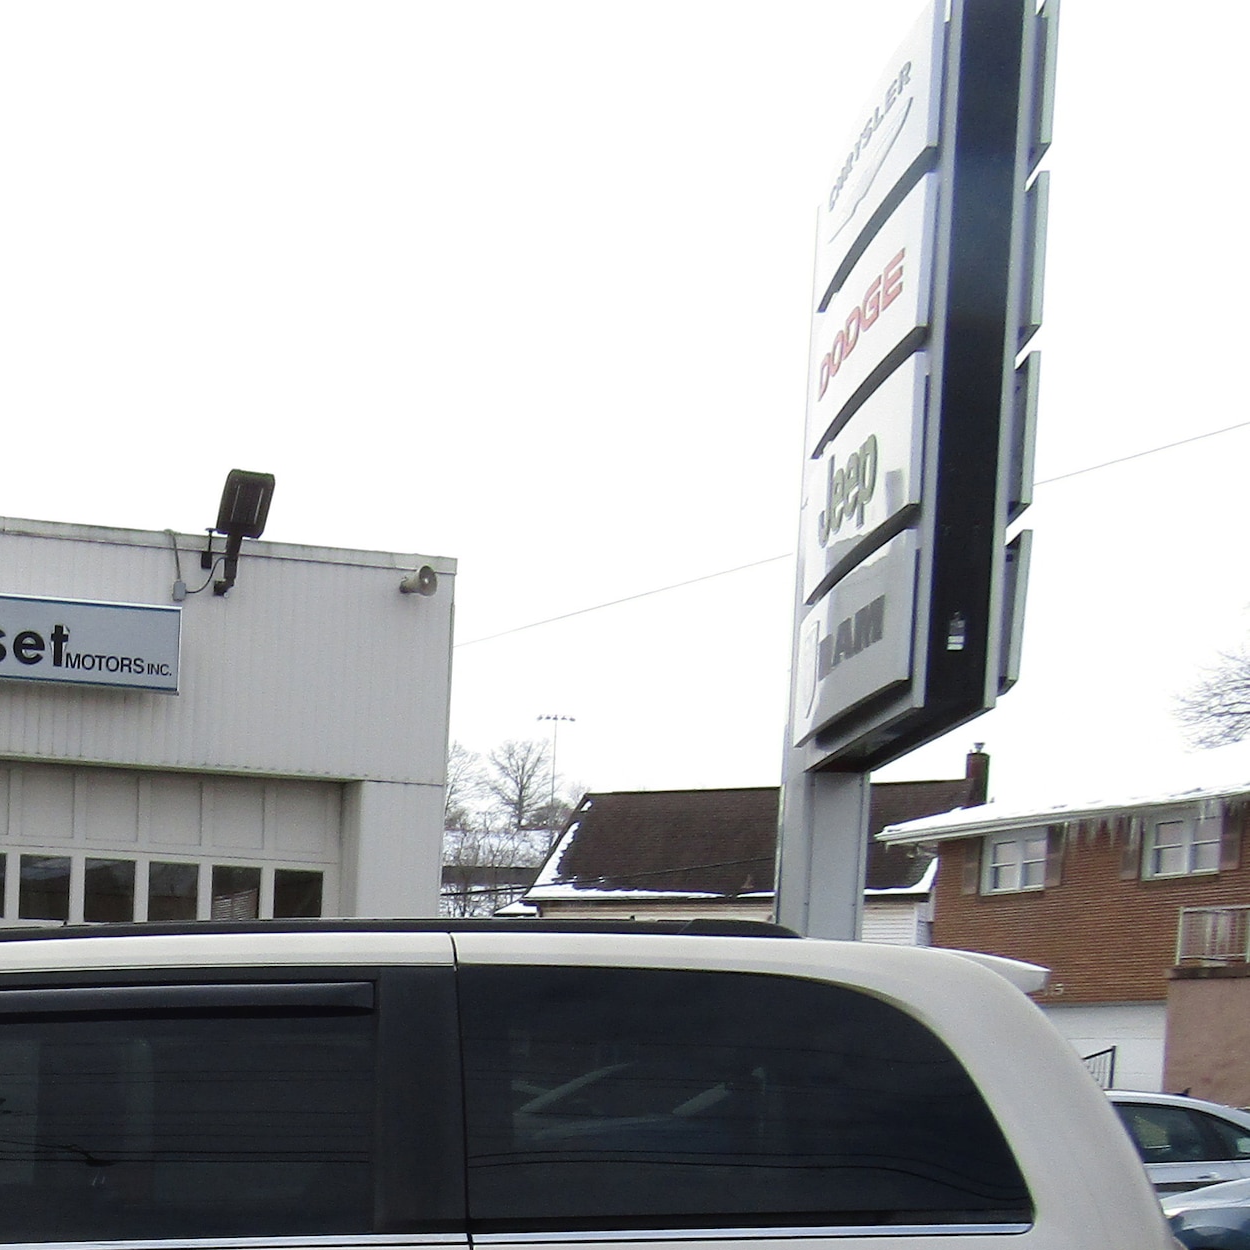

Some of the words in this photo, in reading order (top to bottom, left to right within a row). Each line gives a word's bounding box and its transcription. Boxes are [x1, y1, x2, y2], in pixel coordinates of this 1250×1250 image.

[828, 60, 913, 213] CHRYSLER
[817, 246, 906, 403] DODGE
[817, 433, 878, 549] Jeep
[64, 652, 146, 675] MOTORS
[146, 663, 173, 677] INC.
